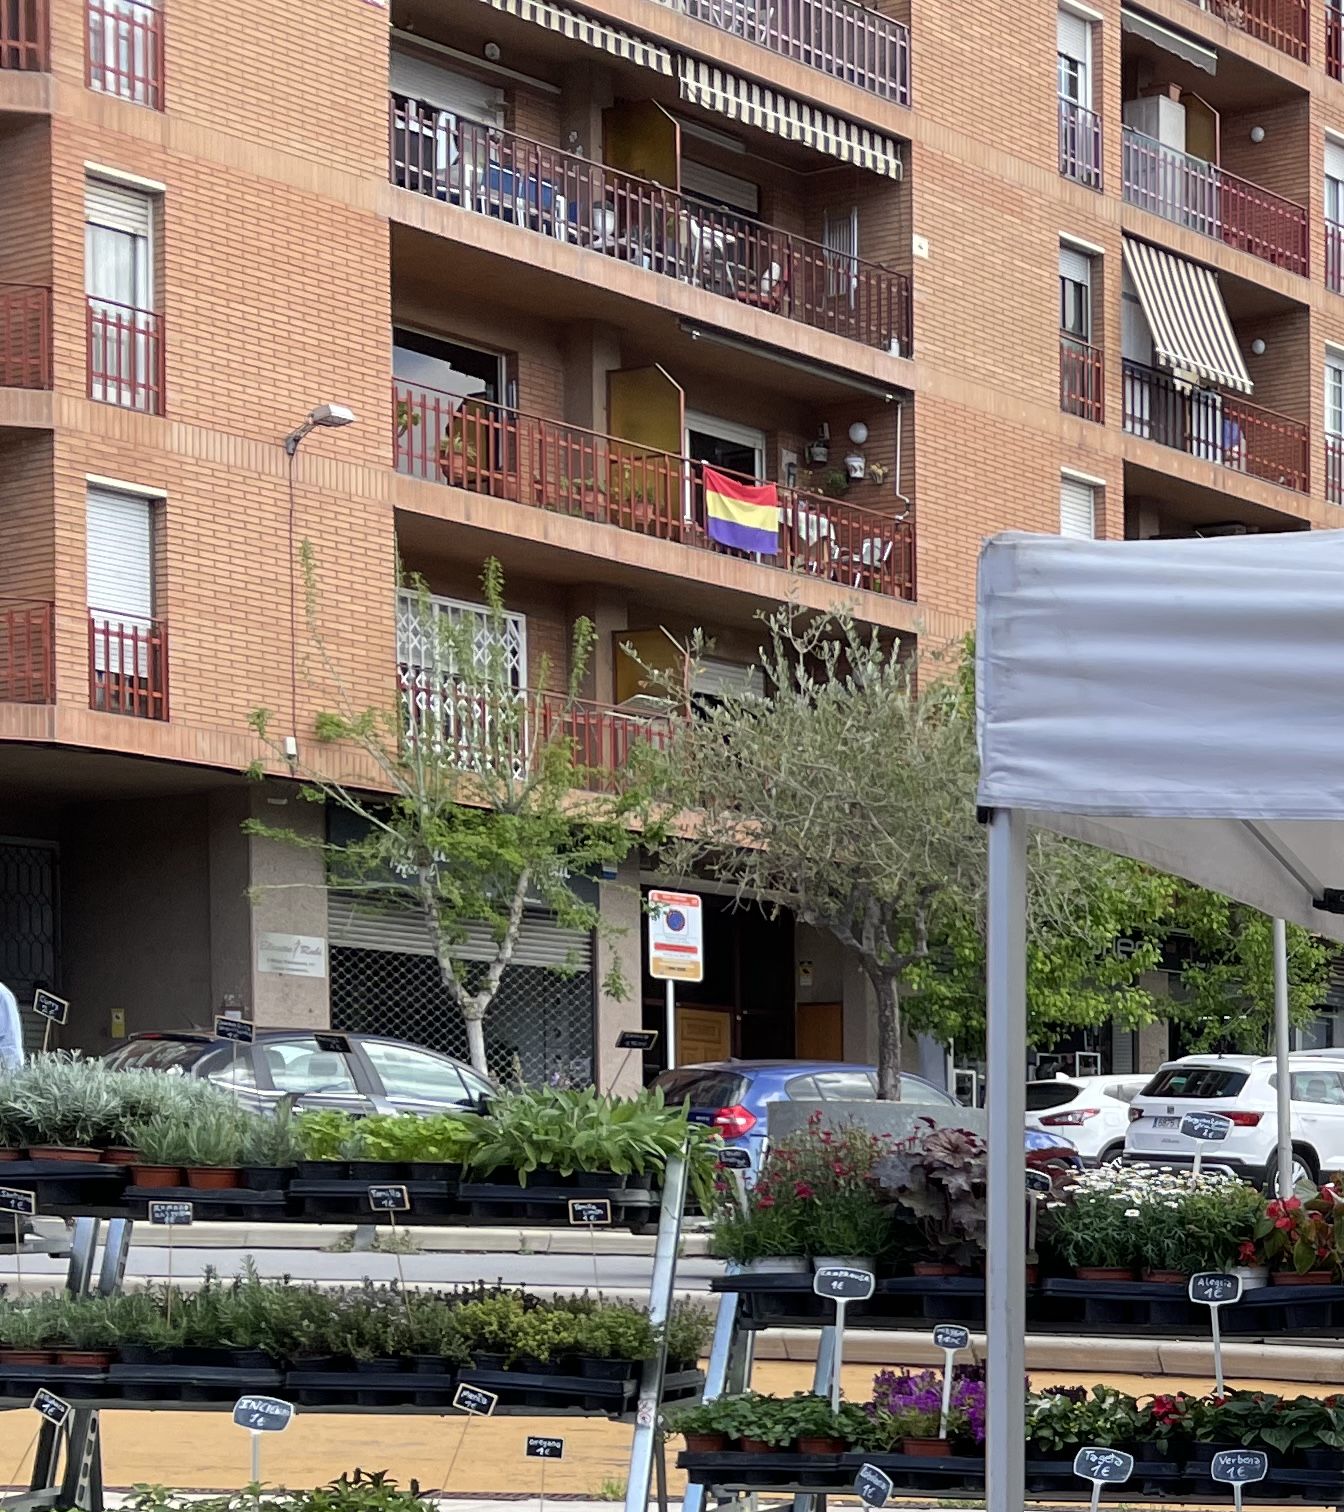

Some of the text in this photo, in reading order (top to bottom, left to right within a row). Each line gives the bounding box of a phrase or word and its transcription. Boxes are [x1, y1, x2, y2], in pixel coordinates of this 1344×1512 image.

[1203, 1287, 1223, 1298] 1€
[1090, 1466, 1110, 1477] 1€
[1226, 1466, 1246, 1478] 1€
